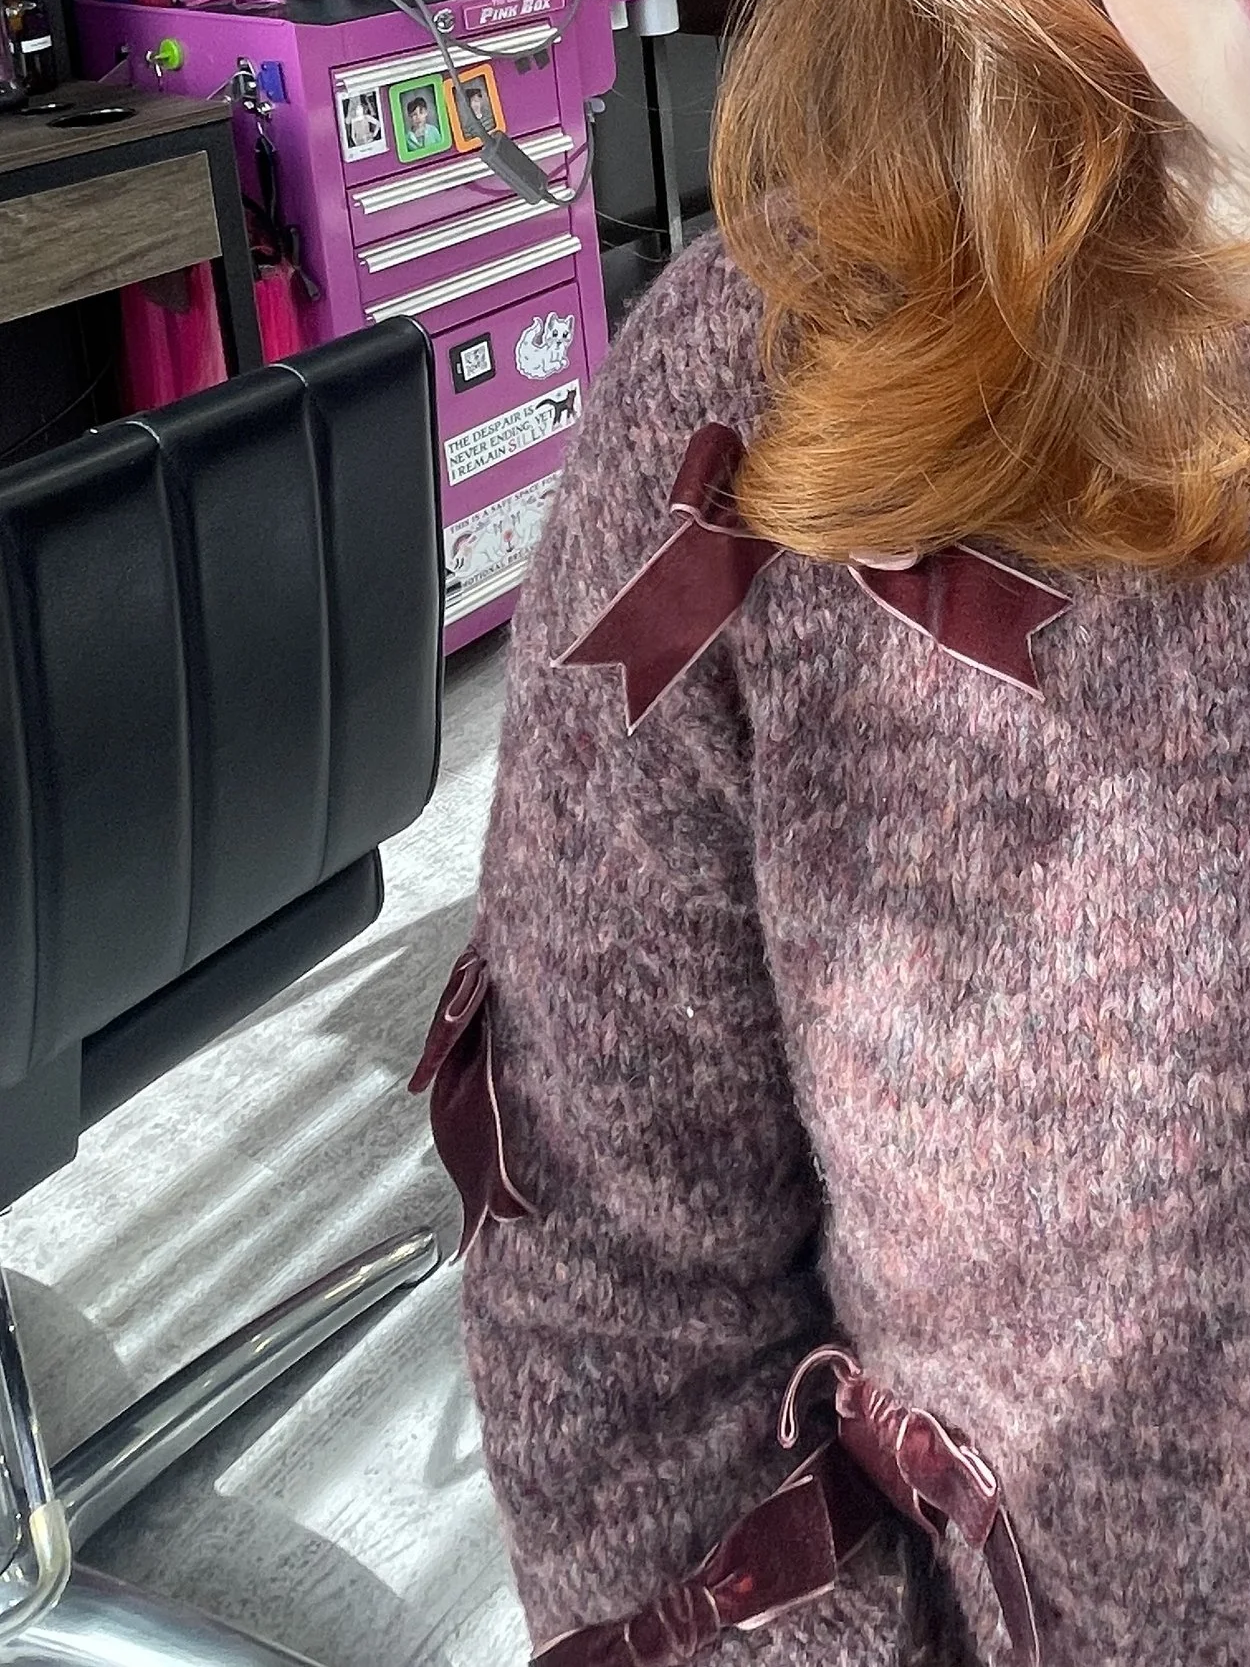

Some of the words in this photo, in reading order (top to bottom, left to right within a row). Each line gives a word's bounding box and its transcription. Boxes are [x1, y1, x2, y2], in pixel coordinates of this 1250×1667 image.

[447, 435, 471, 454] THE
[472, 411, 522, 443] DESPAIR
[523, 404, 535, 417] IS
[449, 442, 487, 467] NEVER
[535, 409, 554, 425] YET
[451, 469, 457, 480] I
[458, 445, 507, 477] REMAIN
[507, 422, 547, 453] SILLY
[450, 519, 470, 534] THIS
[471, 513, 480, 521] IS
[514, 484, 540, 501] SPACE
